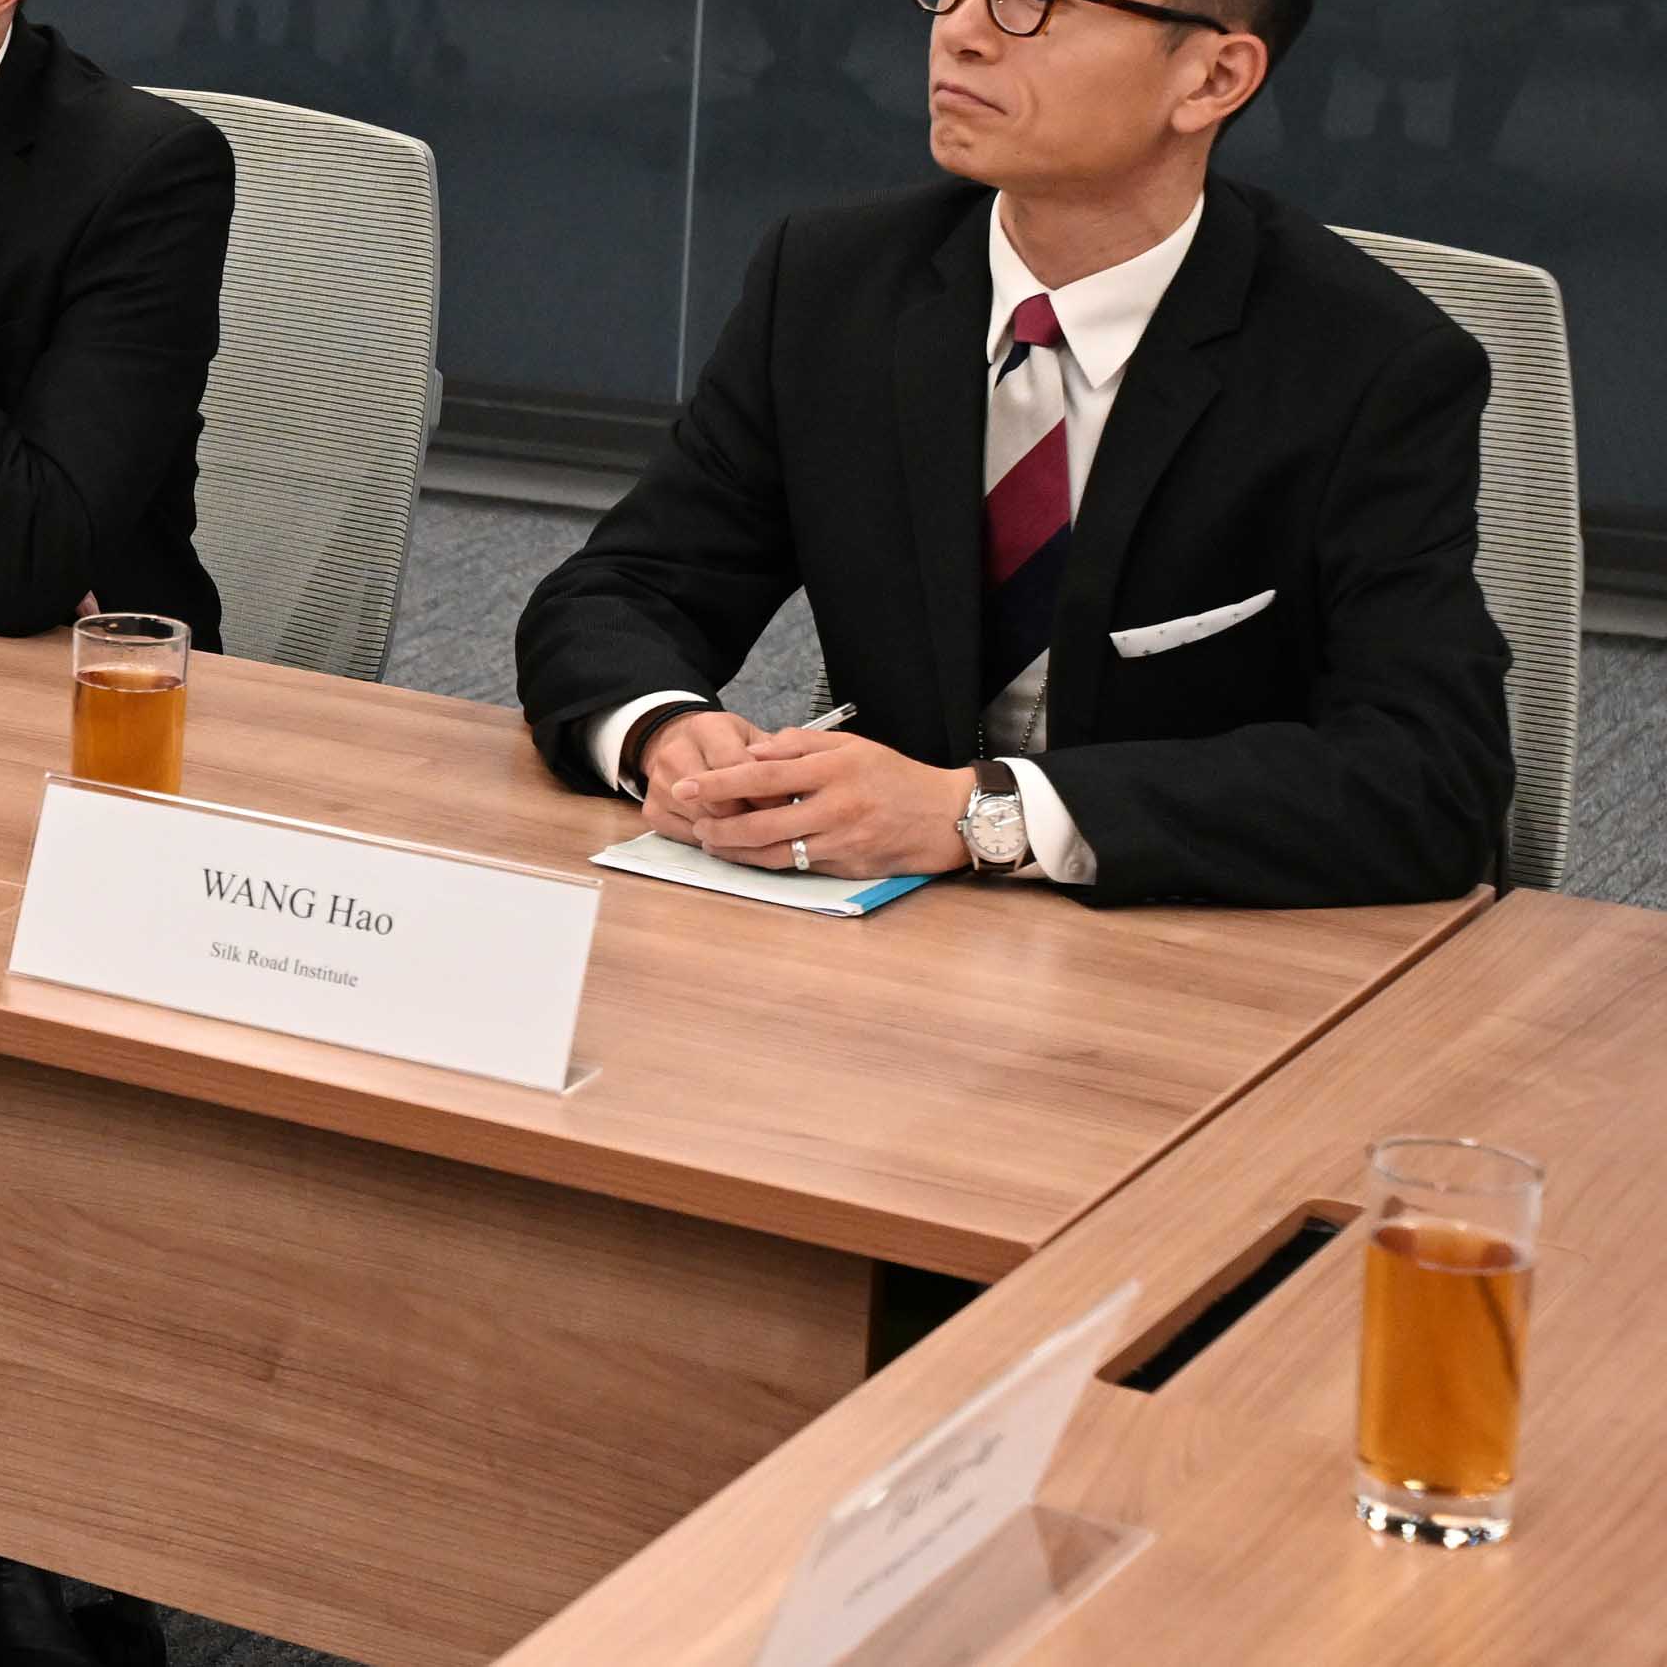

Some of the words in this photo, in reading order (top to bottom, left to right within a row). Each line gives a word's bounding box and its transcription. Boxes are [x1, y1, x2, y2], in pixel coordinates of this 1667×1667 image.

[202, 868, 317, 920] WANG
[328, 894, 394, 936] Hao
[210, 941, 242, 964] Silk
[246, 946, 288, 974] Road
[293, 957, 359, 988] Institute
